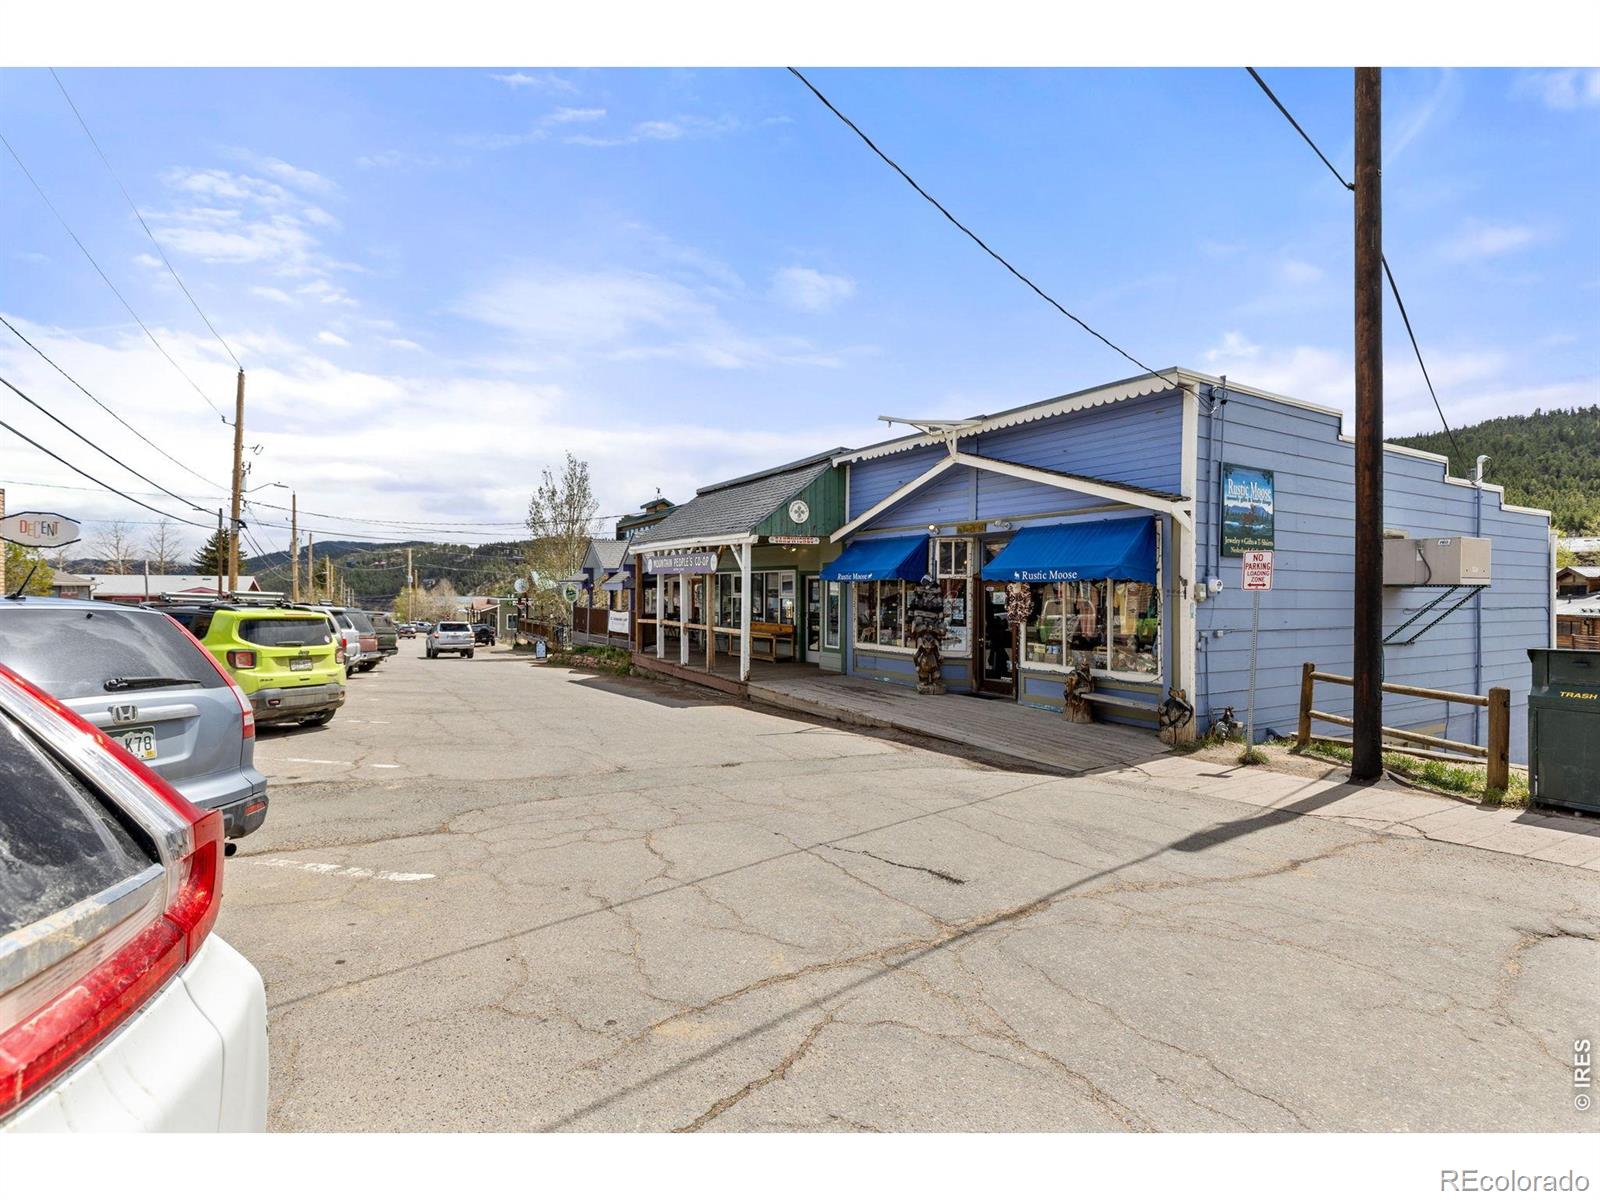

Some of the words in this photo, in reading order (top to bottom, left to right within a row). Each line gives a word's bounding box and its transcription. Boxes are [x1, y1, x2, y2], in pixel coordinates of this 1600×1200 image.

[1228, 479, 1249, 496] Rustic
[1250, 482, 1272, 499] Moose
[20, 520, 60, 539] DECENT
[653, 559, 673, 568] MOUNTAIN
[674, 556, 693, 567] PEOPLE'S
[695, 556, 709, 566] CO-OP
[1022, 570, 1047, 580] Rustic
[1049, 570, 1078, 580] Moose
[1560, 691, 1598, 699] TRASH
